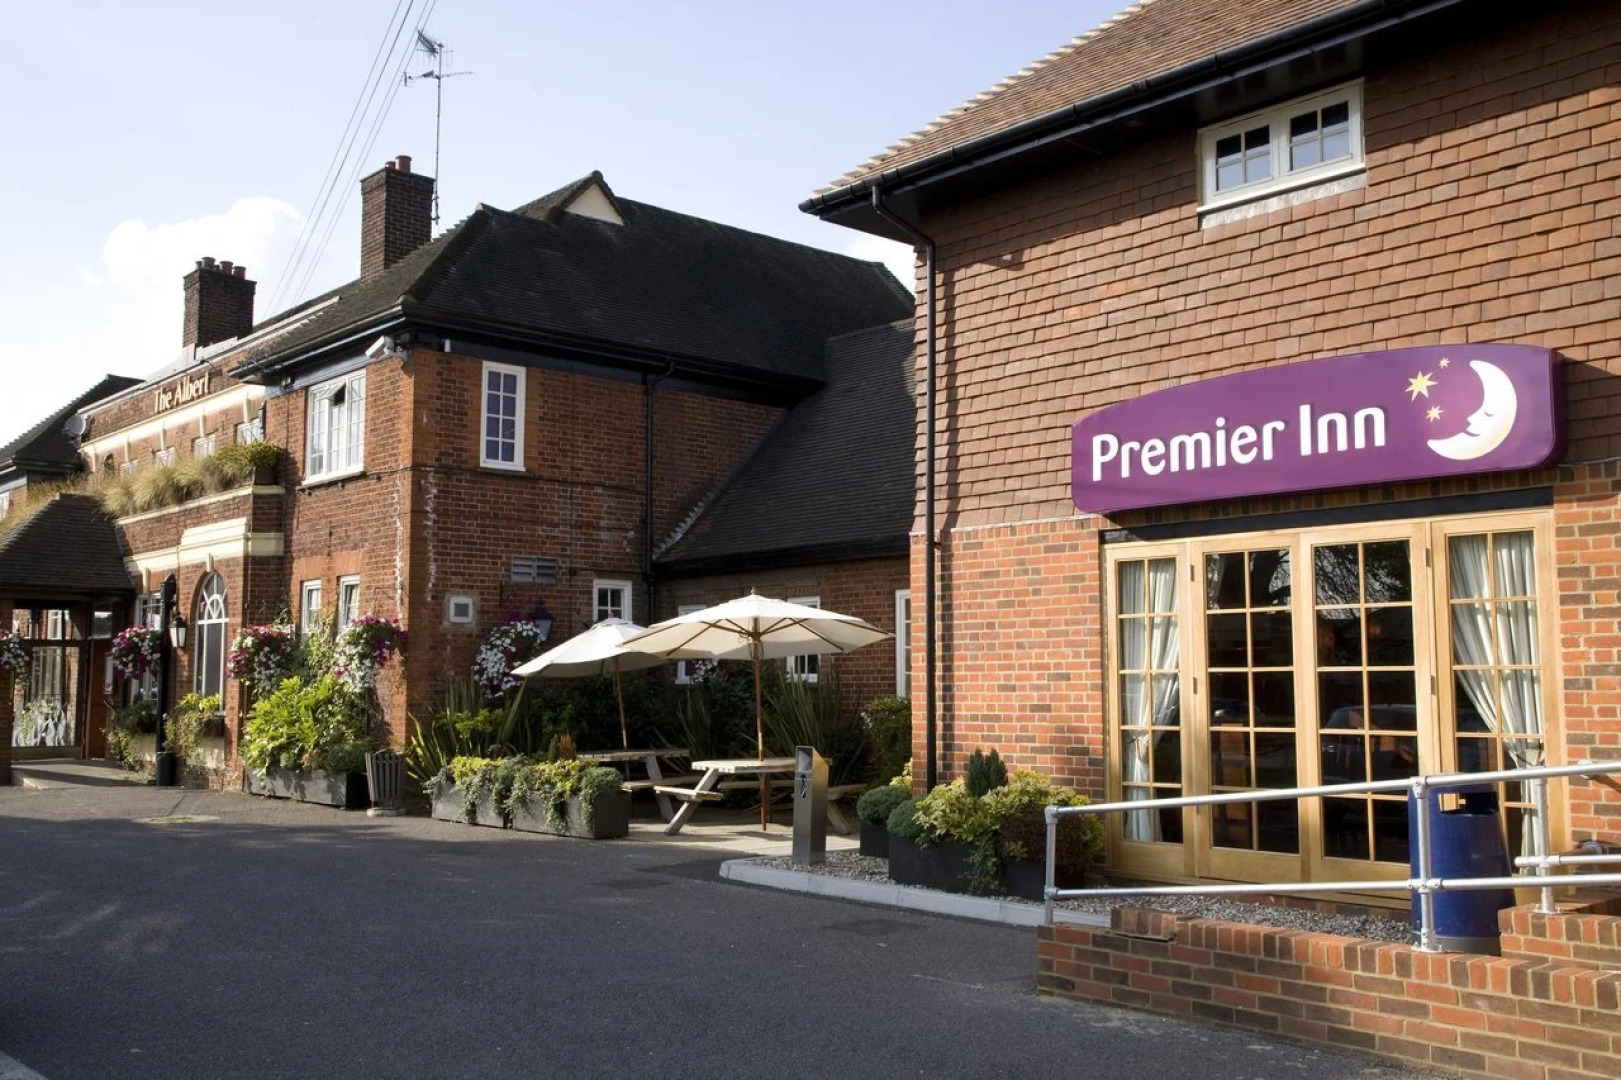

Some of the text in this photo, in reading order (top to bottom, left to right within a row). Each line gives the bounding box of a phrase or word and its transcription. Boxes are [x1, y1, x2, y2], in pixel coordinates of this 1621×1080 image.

[154, 370, 209, 413] The Albert
[1092, 404, 1386, 482] Premier Inn
